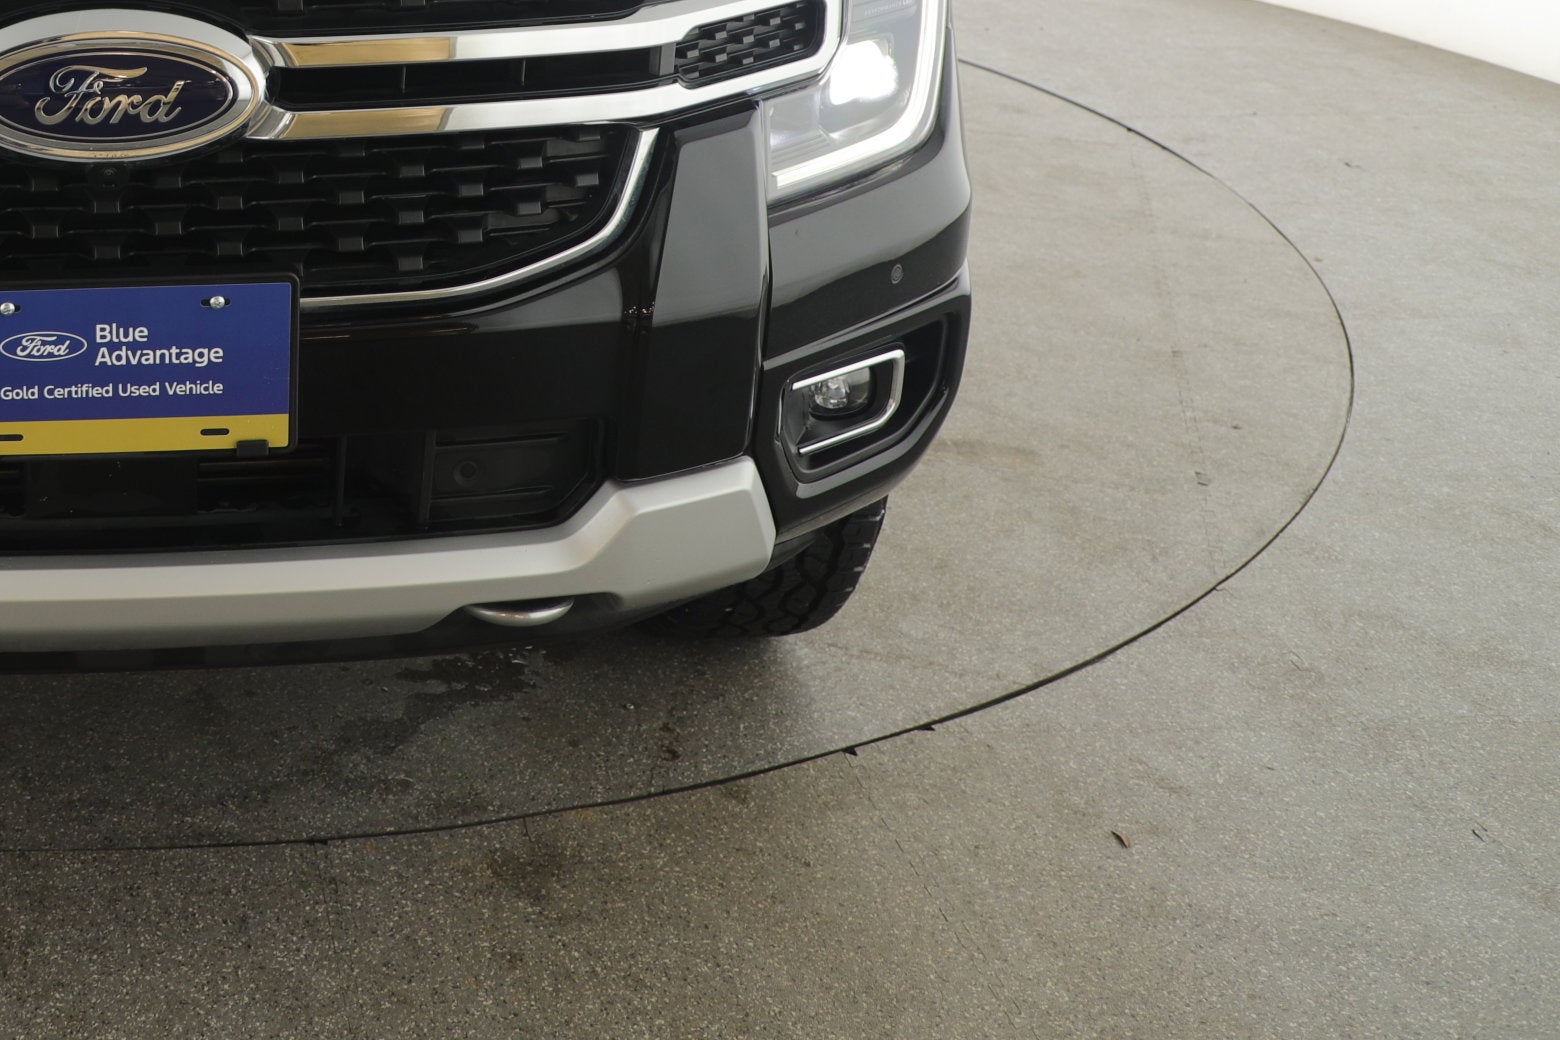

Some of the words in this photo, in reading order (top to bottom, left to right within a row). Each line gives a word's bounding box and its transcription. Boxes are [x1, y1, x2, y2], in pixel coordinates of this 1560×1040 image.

[35, 65, 187, 125] Ford
[95, 323, 148, 343] Blue
[16, 336, 72, 357] Ford
[95, 345, 224, 367] Advantage
[0, 384, 39, 400] Gold
[43, 382, 113, 399] Certified
[118, 381, 160, 396] Used
[165, 380, 224, 395] Vehicle
